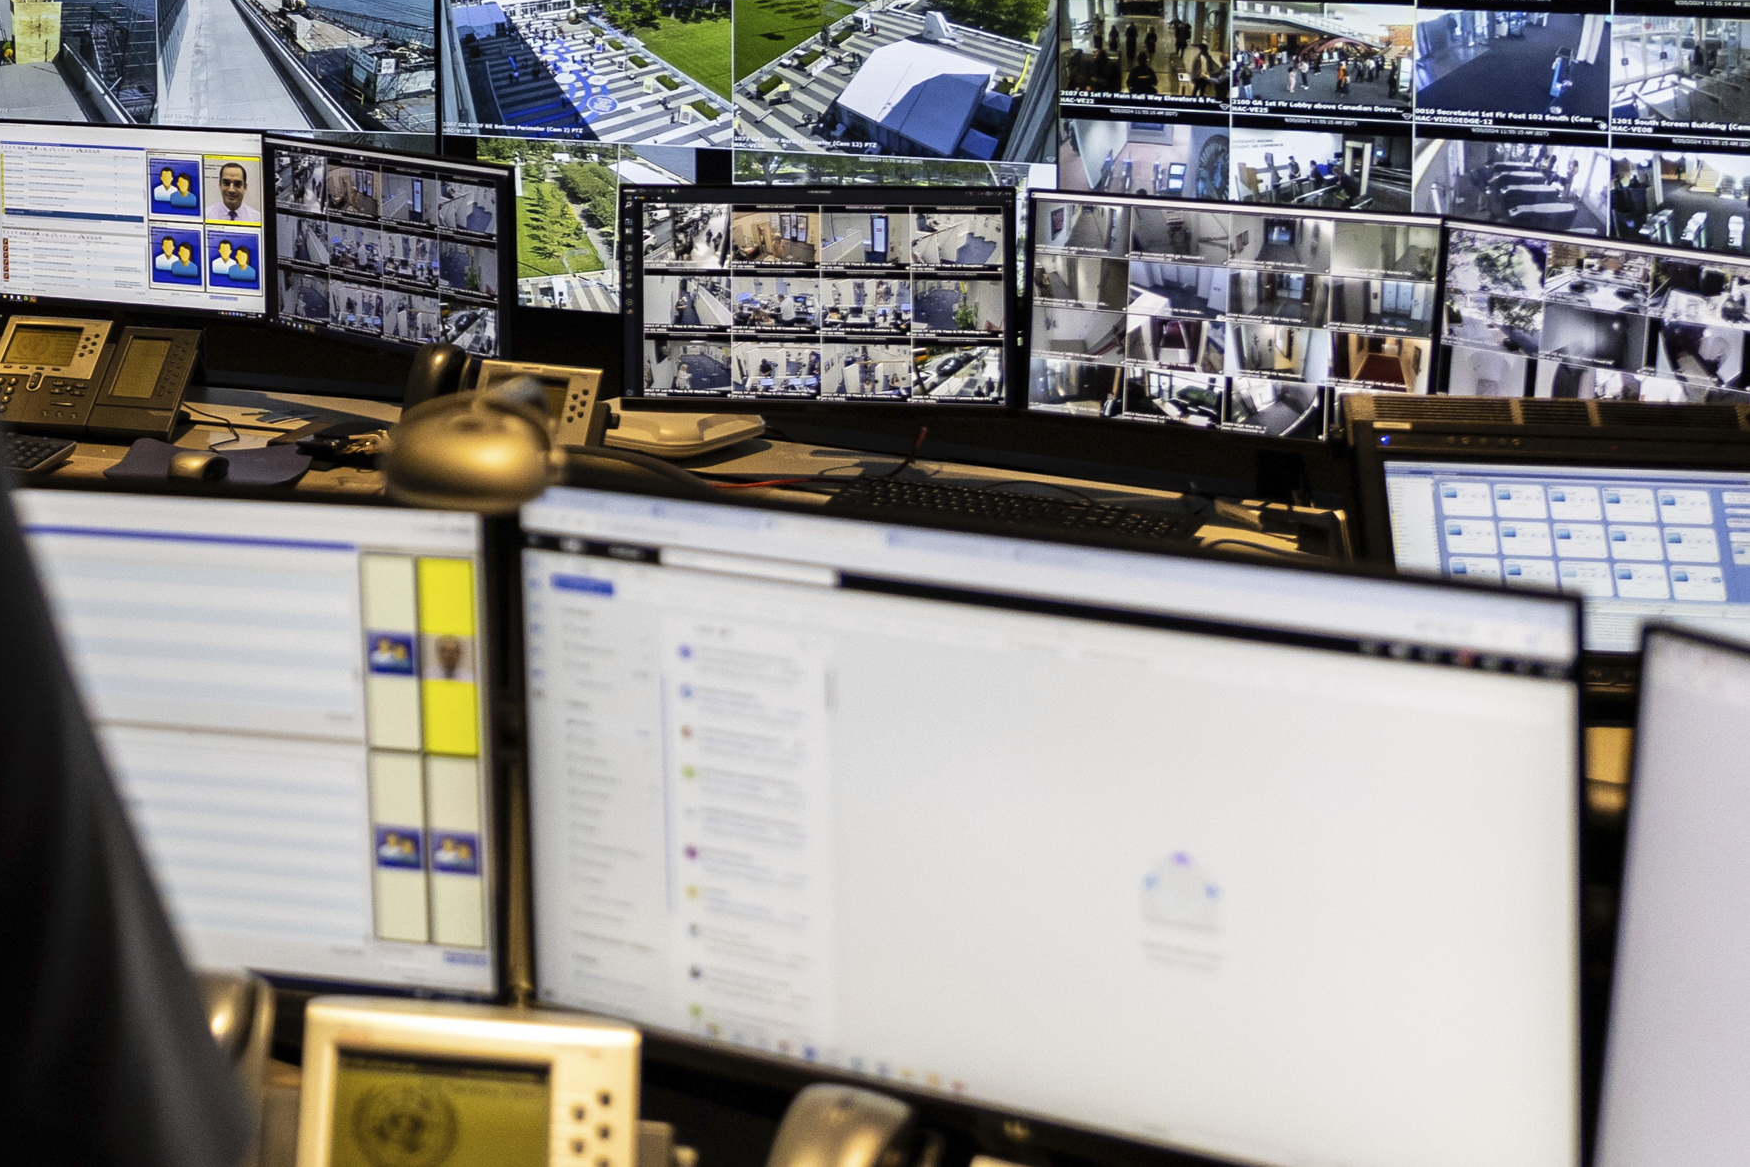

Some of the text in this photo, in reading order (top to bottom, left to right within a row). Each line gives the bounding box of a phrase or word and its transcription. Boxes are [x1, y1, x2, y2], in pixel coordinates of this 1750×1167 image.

[1289, 101, 1312, 110] Lobby
[1436, 109, 1479, 117] Secretariat
[1570, 115, 1592, 124] (Cam
[1660, 120, 1689, 128] Screen
[1691, 122, 1727, 131] Building
